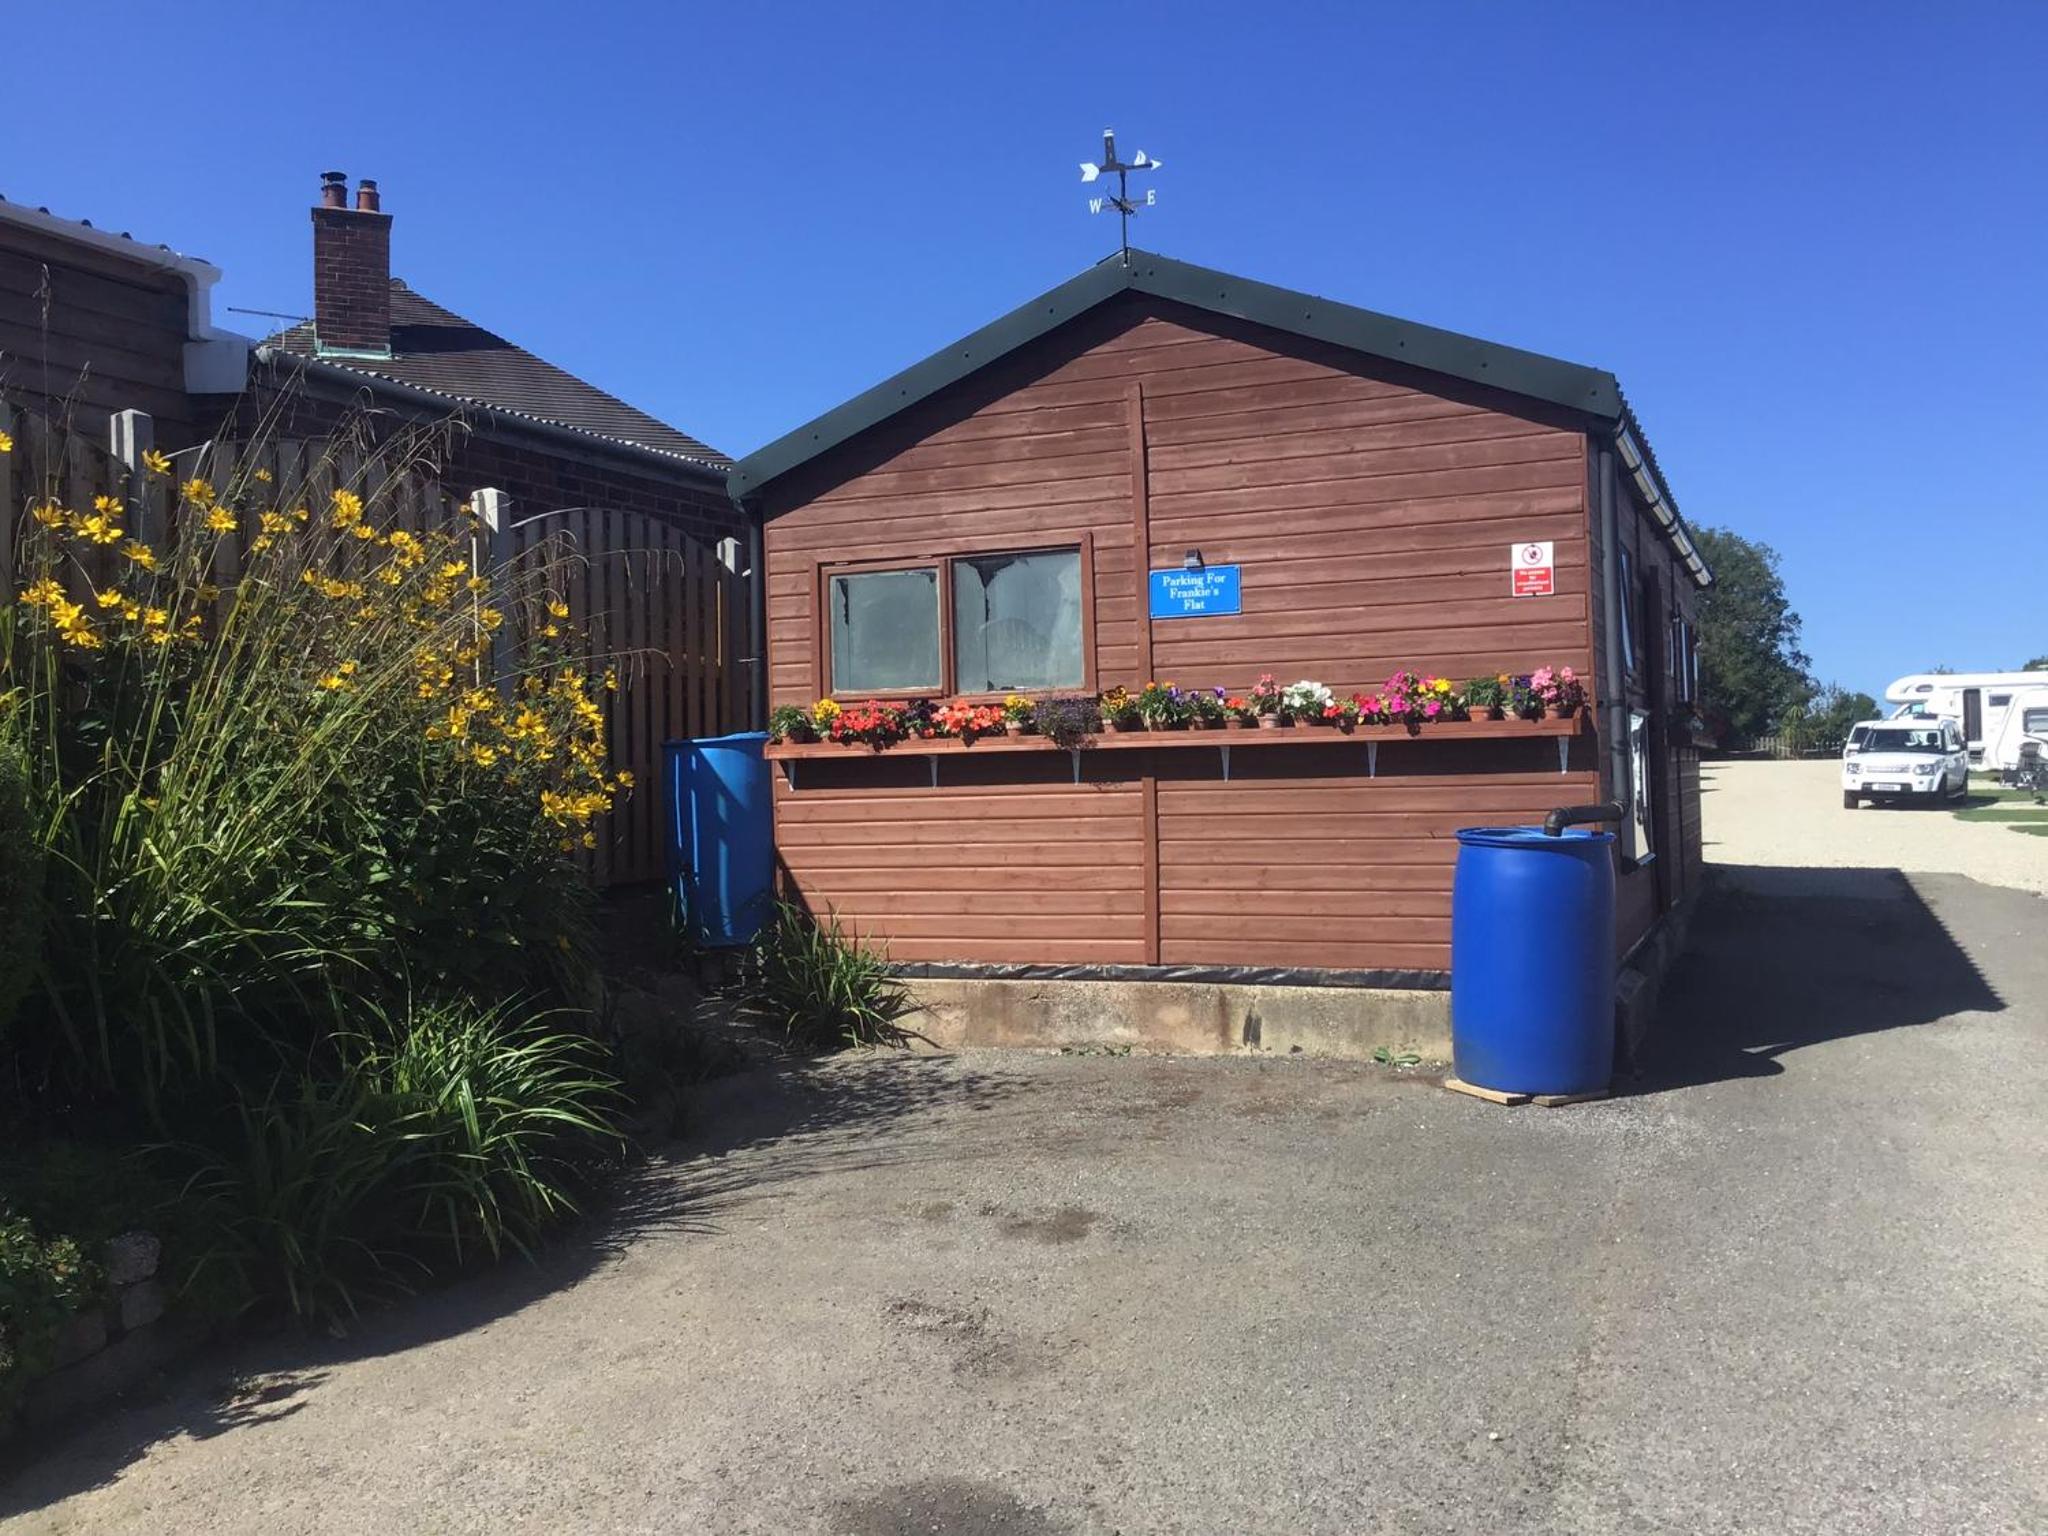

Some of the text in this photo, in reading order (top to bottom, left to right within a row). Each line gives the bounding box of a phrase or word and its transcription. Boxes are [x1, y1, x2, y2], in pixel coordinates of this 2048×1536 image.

[1147, 190, 1156, 206] E
[1089, 198, 1102, 214] W
[1162, 573, 1226, 588] Parking For
[1170, 586, 1219, 599] Frankie's
[1184, 599, 1205, 610] Flat
